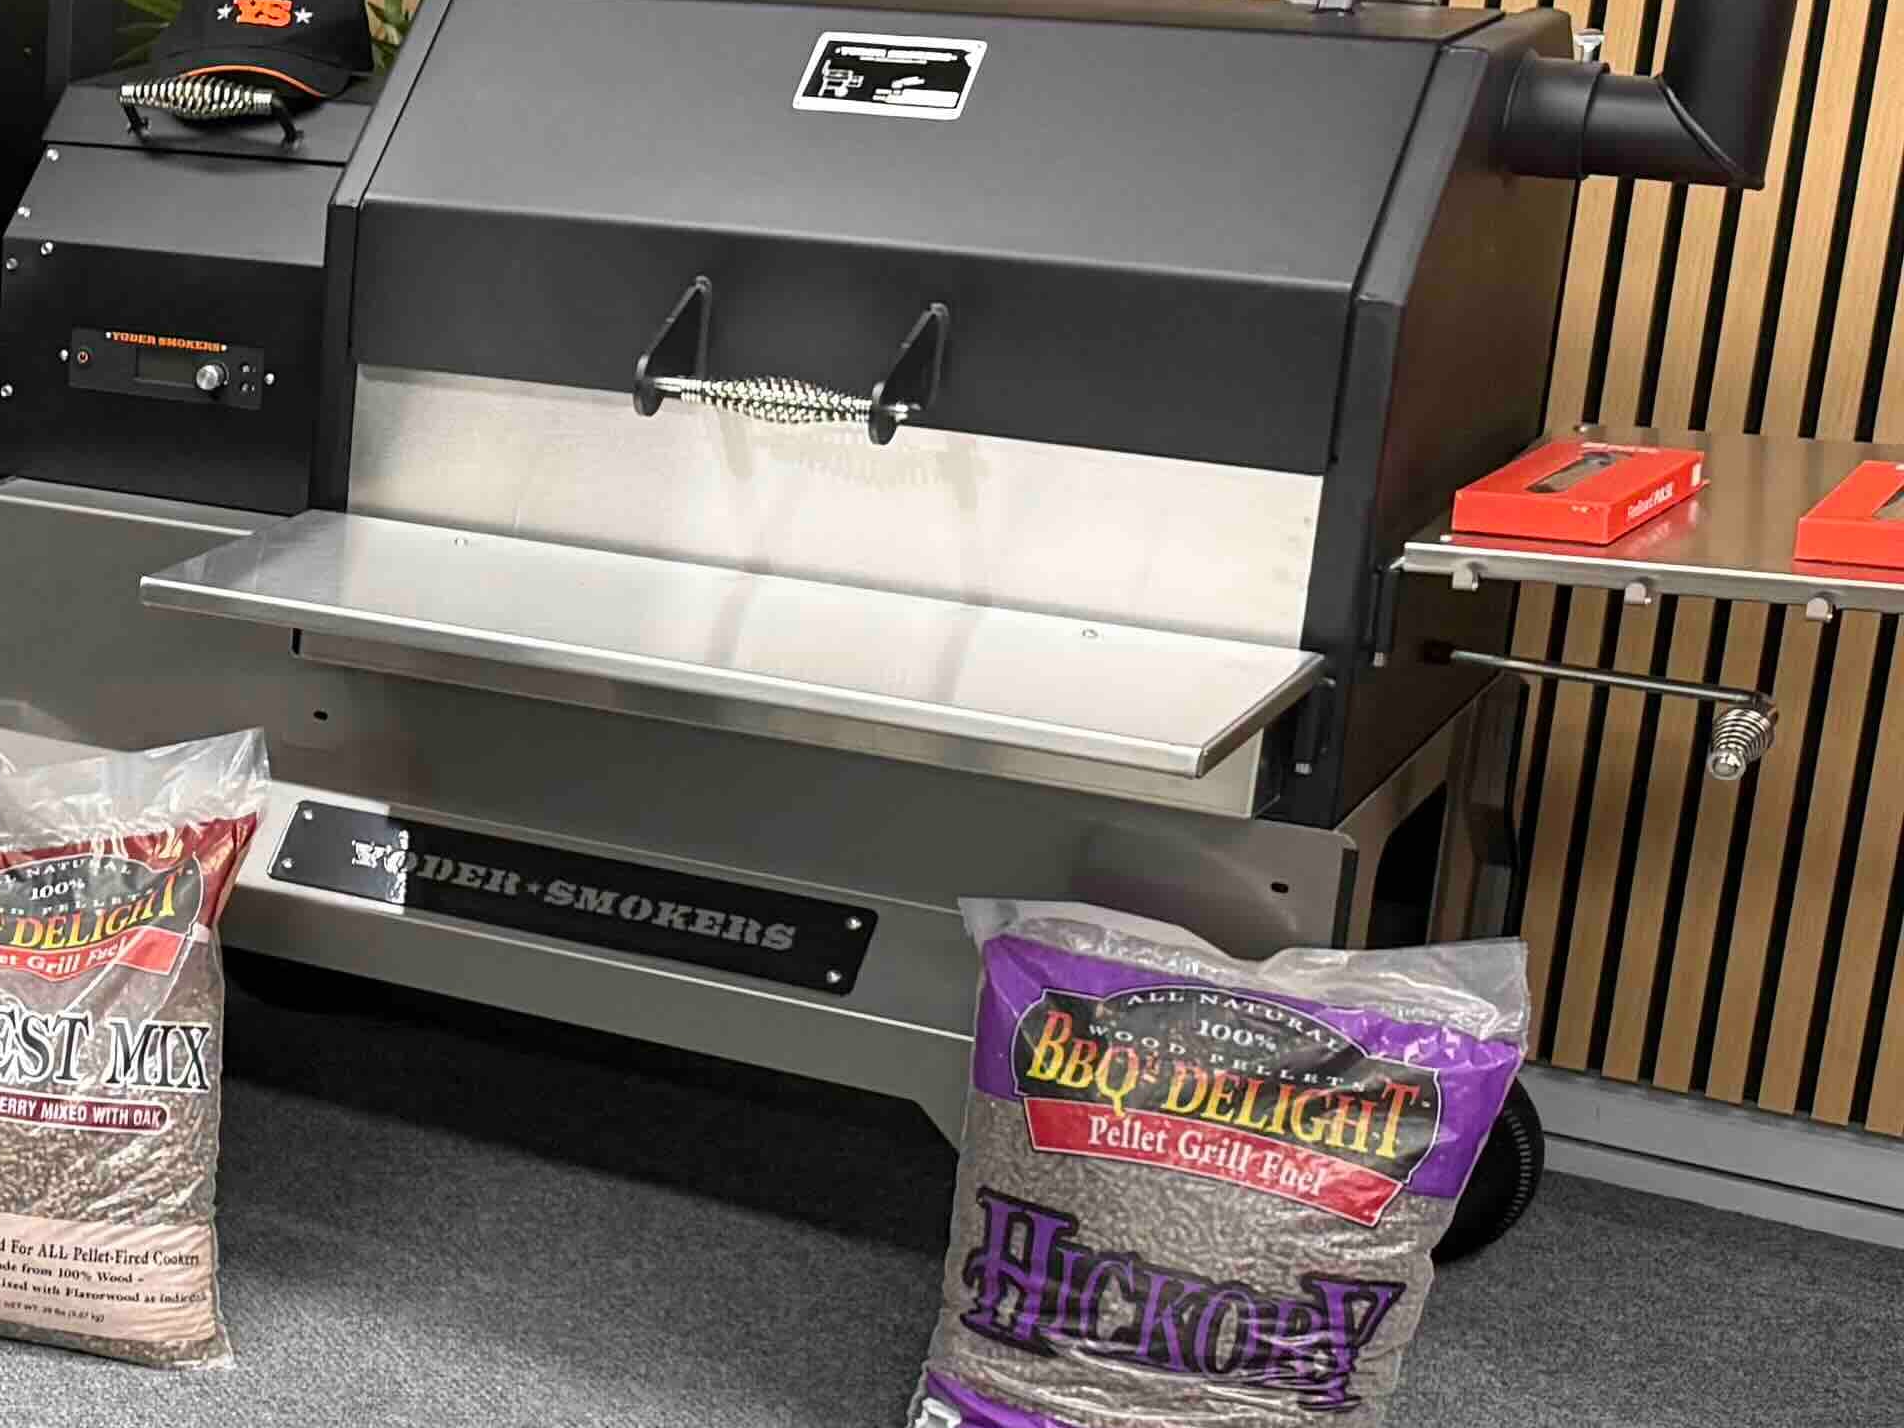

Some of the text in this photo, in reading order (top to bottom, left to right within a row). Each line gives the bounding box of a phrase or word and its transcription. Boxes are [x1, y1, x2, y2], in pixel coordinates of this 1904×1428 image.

[111, 331, 222, 353] YODER SMOKERS
[27, 857, 132, 880] NATURAL
[28, 878, 87, 901] 100%
[351, 838, 797, 952] YODER SMOKERS
[10, 872, 178, 950] DELIGHT
[26, 953, 81, 976] Grill
[1128, 991, 1345, 1053] ALL NATURAL
[1196, 1018, 1278, 1054] 100%
[105, 1018, 212, 1093] MIX
[1087, 1022, 1367, 1093] WOOD PELLETS
[41, 1102, 88, 1123] MIXED
[93, 1105, 129, 1125] WITH
[132, 1110, 162, 1128] OAK
[1160, 1059, 1421, 1159] DELIGHT
[1090, 1114, 1328, 1197] Pellet Grill Fuel
[11, 1239, 35, 1256] For
[38, 1244, 69, 1261] ALL
[73, 1247, 150, 1266] Pellet-Fired
[21, 1263, 53, 1278] from
[58, 1267, 93, 1283] 100%
[97, 1271, 134, 1285] Wood
[33, 1283, 61, 1296] with
[65, 1286, 141, 1304] Flavorwood
[960, 1187, 1406, 1413] HICKORY
